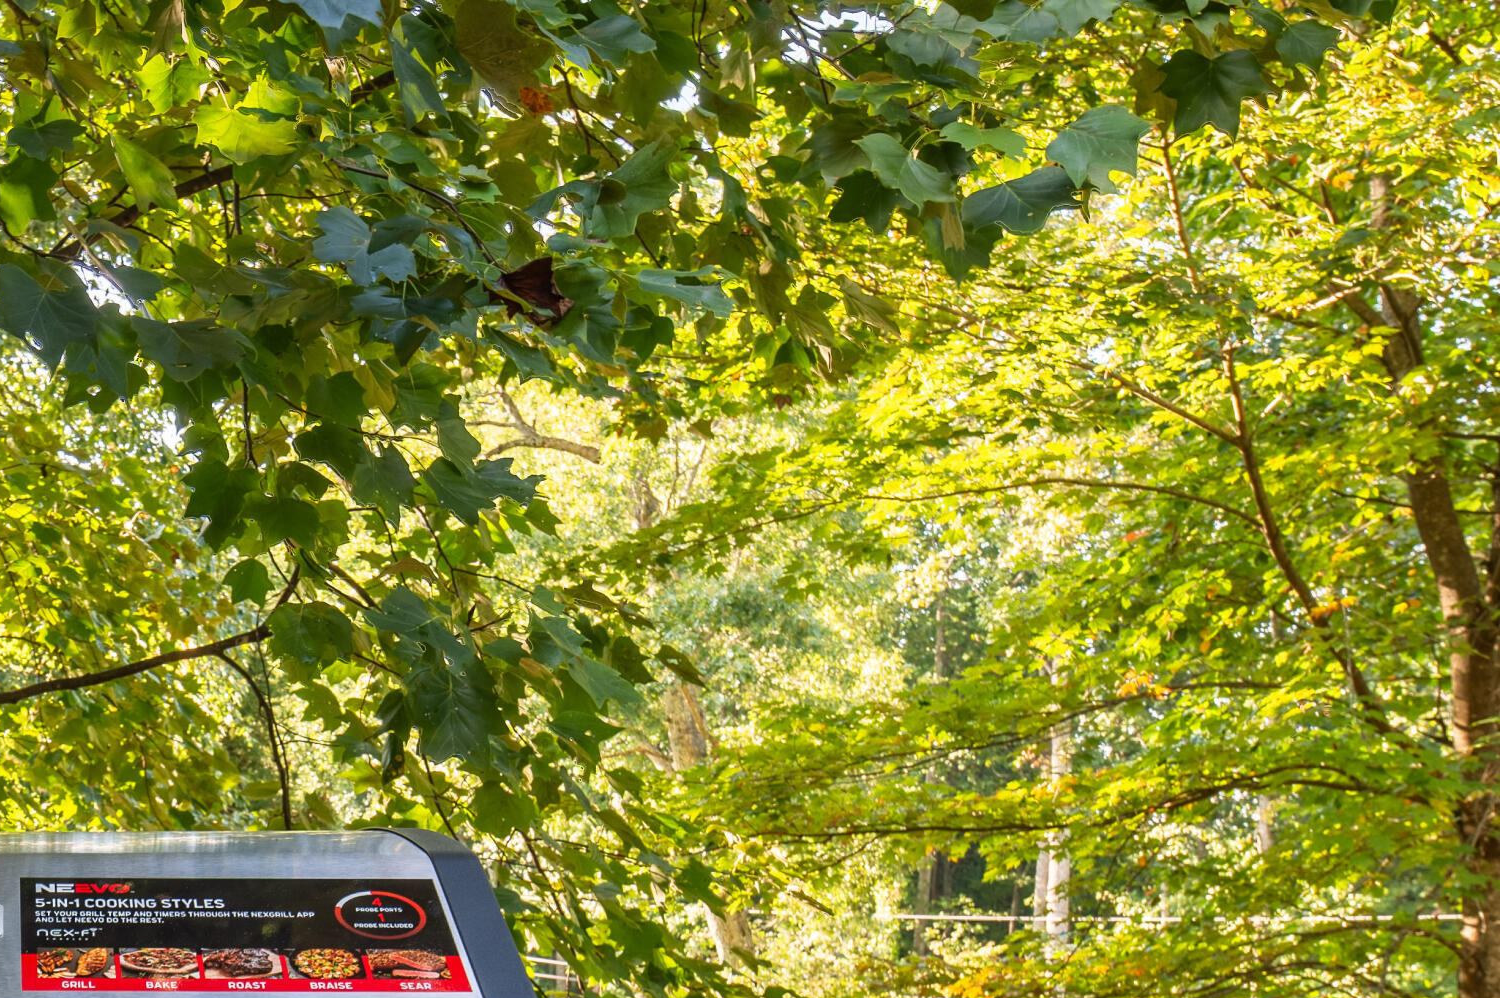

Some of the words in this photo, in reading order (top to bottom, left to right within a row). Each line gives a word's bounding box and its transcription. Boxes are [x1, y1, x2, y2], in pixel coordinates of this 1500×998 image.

[35, 883, 131, 894] NEEVO
[35, 898, 80, 909] 5-IN-1
[84, 898, 157, 909] COOKING
[161, 898, 226, 909] STYLES
[372, 897, 382, 906] 4
[377, 913, 385, 922] 1
[61, 980, 96, 989] GRILL
[145, 980, 178, 989] BAKE
[228, 981, 267, 990] ROAST
[309, 981, 353, 990] BRAISE
[399, 981, 432, 990] SEAR
